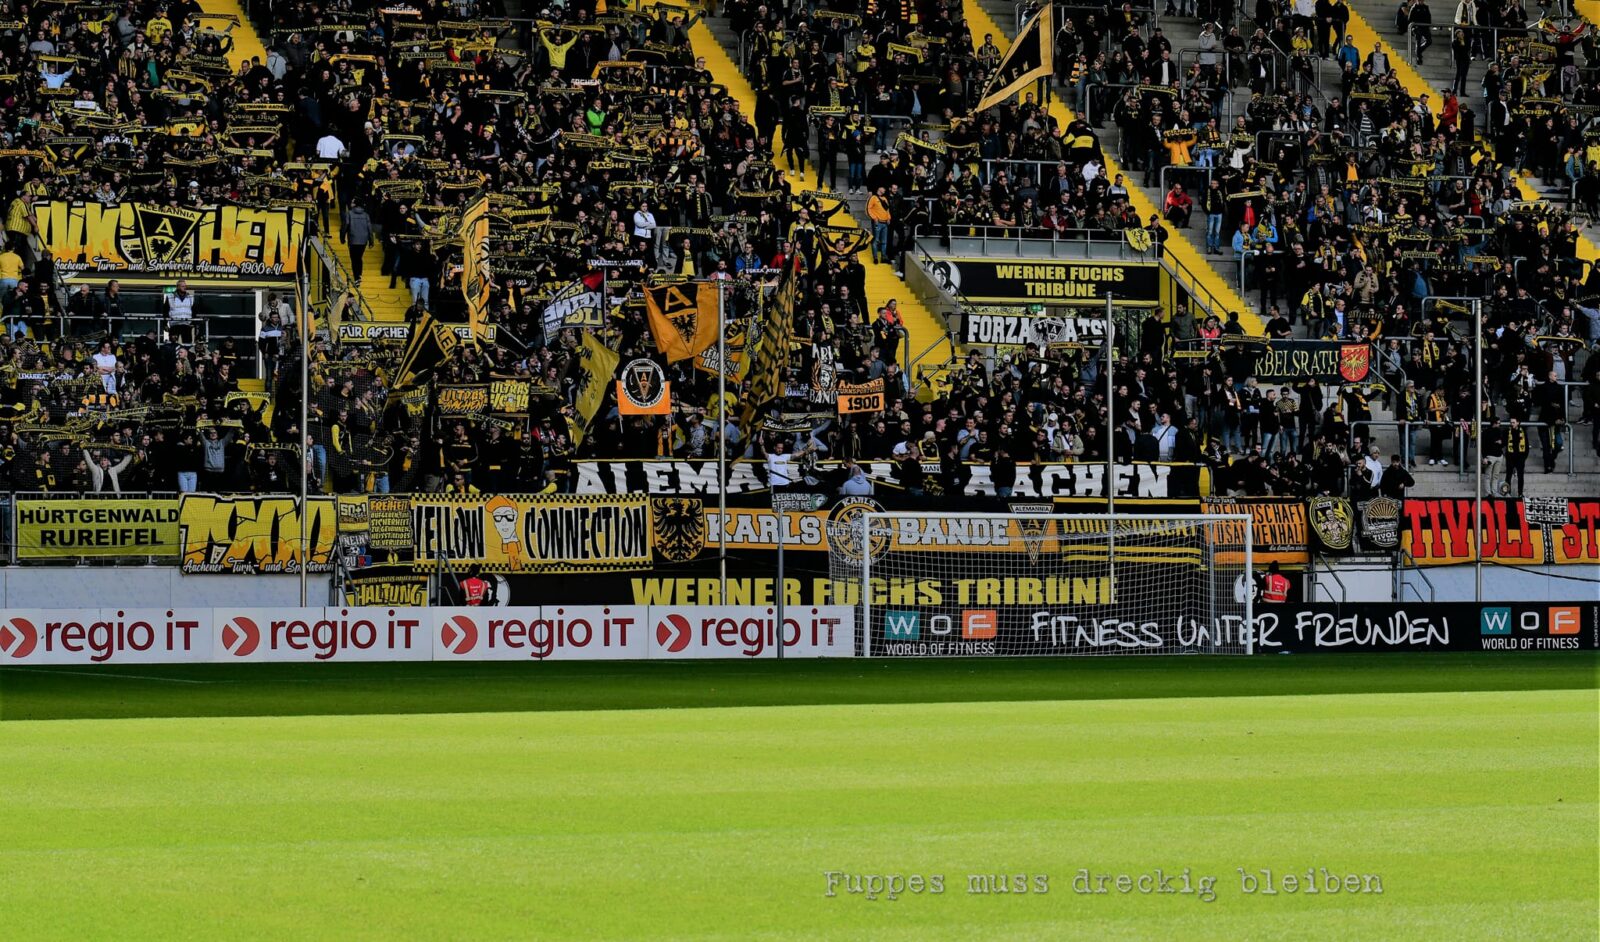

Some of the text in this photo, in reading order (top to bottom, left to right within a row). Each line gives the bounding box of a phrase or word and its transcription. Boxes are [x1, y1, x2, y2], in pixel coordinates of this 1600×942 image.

[54, 256, 90, 271] Aachener
[92, 256, 123, 272] Turn-
[128, 259, 144, 272] und
[196, 259, 239, 274] Alemannia
[240, 261, 266, 275] 1900
[996, 265, 1124, 281] WERNER FUCHS
[1024, 280, 1096, 297] TRIBÜNE
[340, 324, 364, 338] FÜR
[967, 317, 1029, 343] FORZA
[491, 381, 530, 395] ULTRAS
[847, 395, 880, 410] 1900
[962, 464, 1171, 498] AACHEN
[370, 499, 409, 511] FREIHEIT
[771, 493, 811, 501] LEGENDEN
[841, 496, 876, 508] KARLS
[20, 507, 178, 524] HÜRTGENWALD
[340, 502, 367, 516] 50+1
[371, 518, 409, 526] SICHERHEIT
[706, 513, 1010, 546] KARLS BANDE
[1402, 499, 1534, 558] TIVOLI
[41, 529, 164, 546] RUREIFEL
[413, 503, 649, 560] YELLOW CONNECTION
[182, 559, 224, 573] Aachener
[265, 560, 282, 573] und
[285, 559, 335, 574] Sprtverein
[355, 583, 421, 606] HALTUNG
[631, 574, 1118, 606] WERNER FUCHS TRIBÜNE
[887, 614, 993, 635] W O F
[1031, 611, 1450, 648] FITNESS UNTER FREUNDEN
[1483, 610, 1576, 631] W O F
[45, 610, 199, 662] regio iT
[270, 609, 420, 660] regio iT
[488, 608, 635, 658] regio iT
[701, 607, 841, 657] regio iT
[886, 642, 995, 656] WORLD OF FITNESS
[1481, 637, 1580, 650] WORLD OF FITNESS
